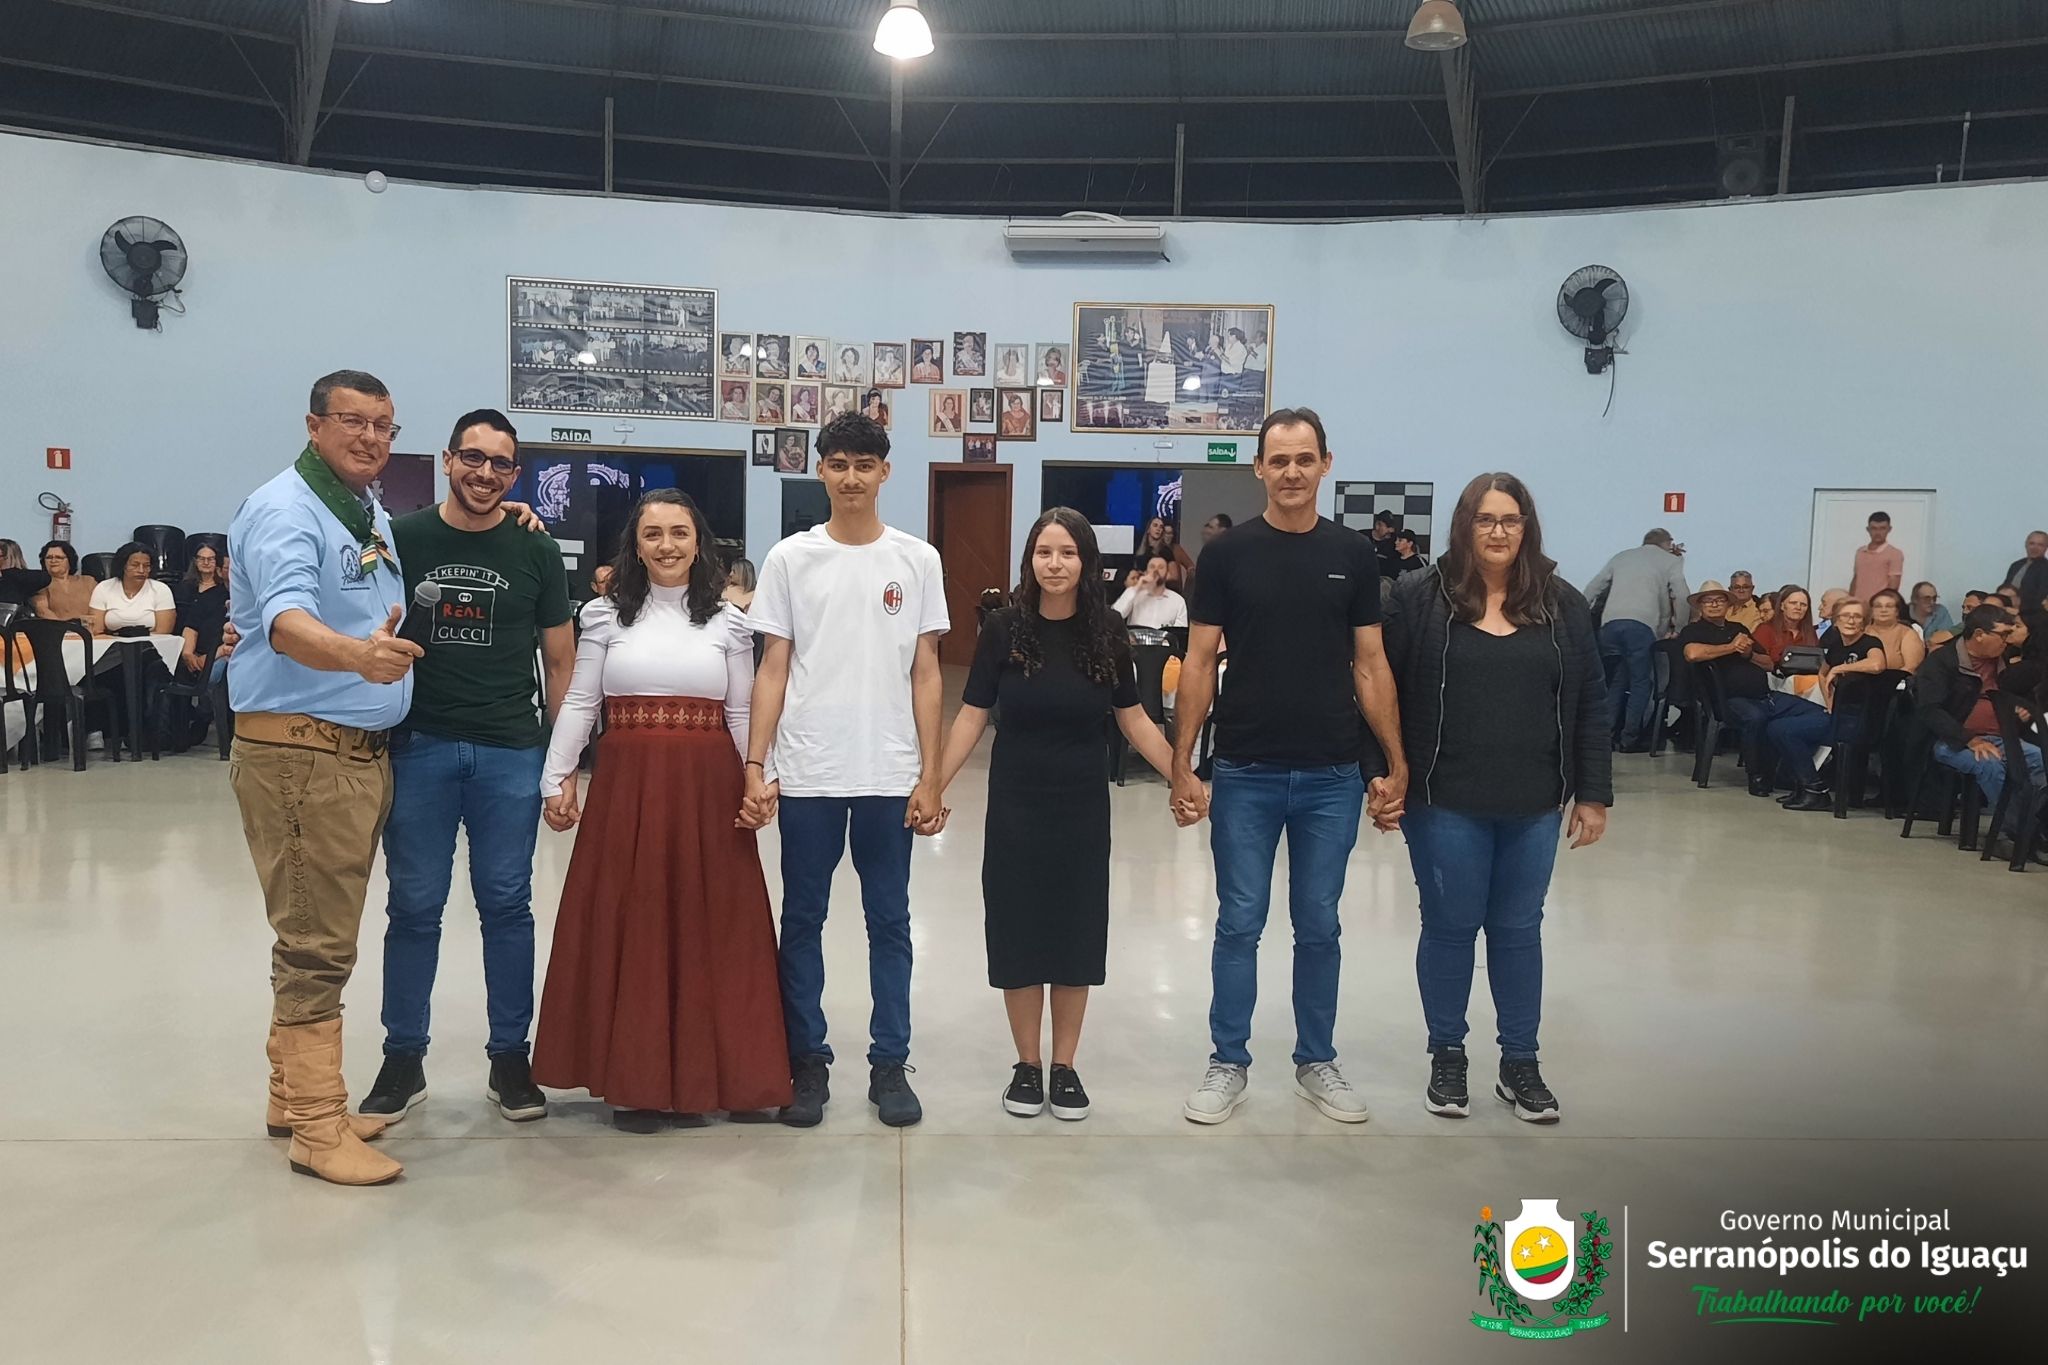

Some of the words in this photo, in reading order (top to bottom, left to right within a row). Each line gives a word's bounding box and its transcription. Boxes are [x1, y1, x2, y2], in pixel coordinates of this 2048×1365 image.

[552, 430, 591, 442] SAÍDA
[1208, 447, 1229, 456] SAÍDA
[441, 568, 479, 577] KEEPIN'
[482, 571, 493, 581] IT
[438, 626, 485, 641] GUCCI
